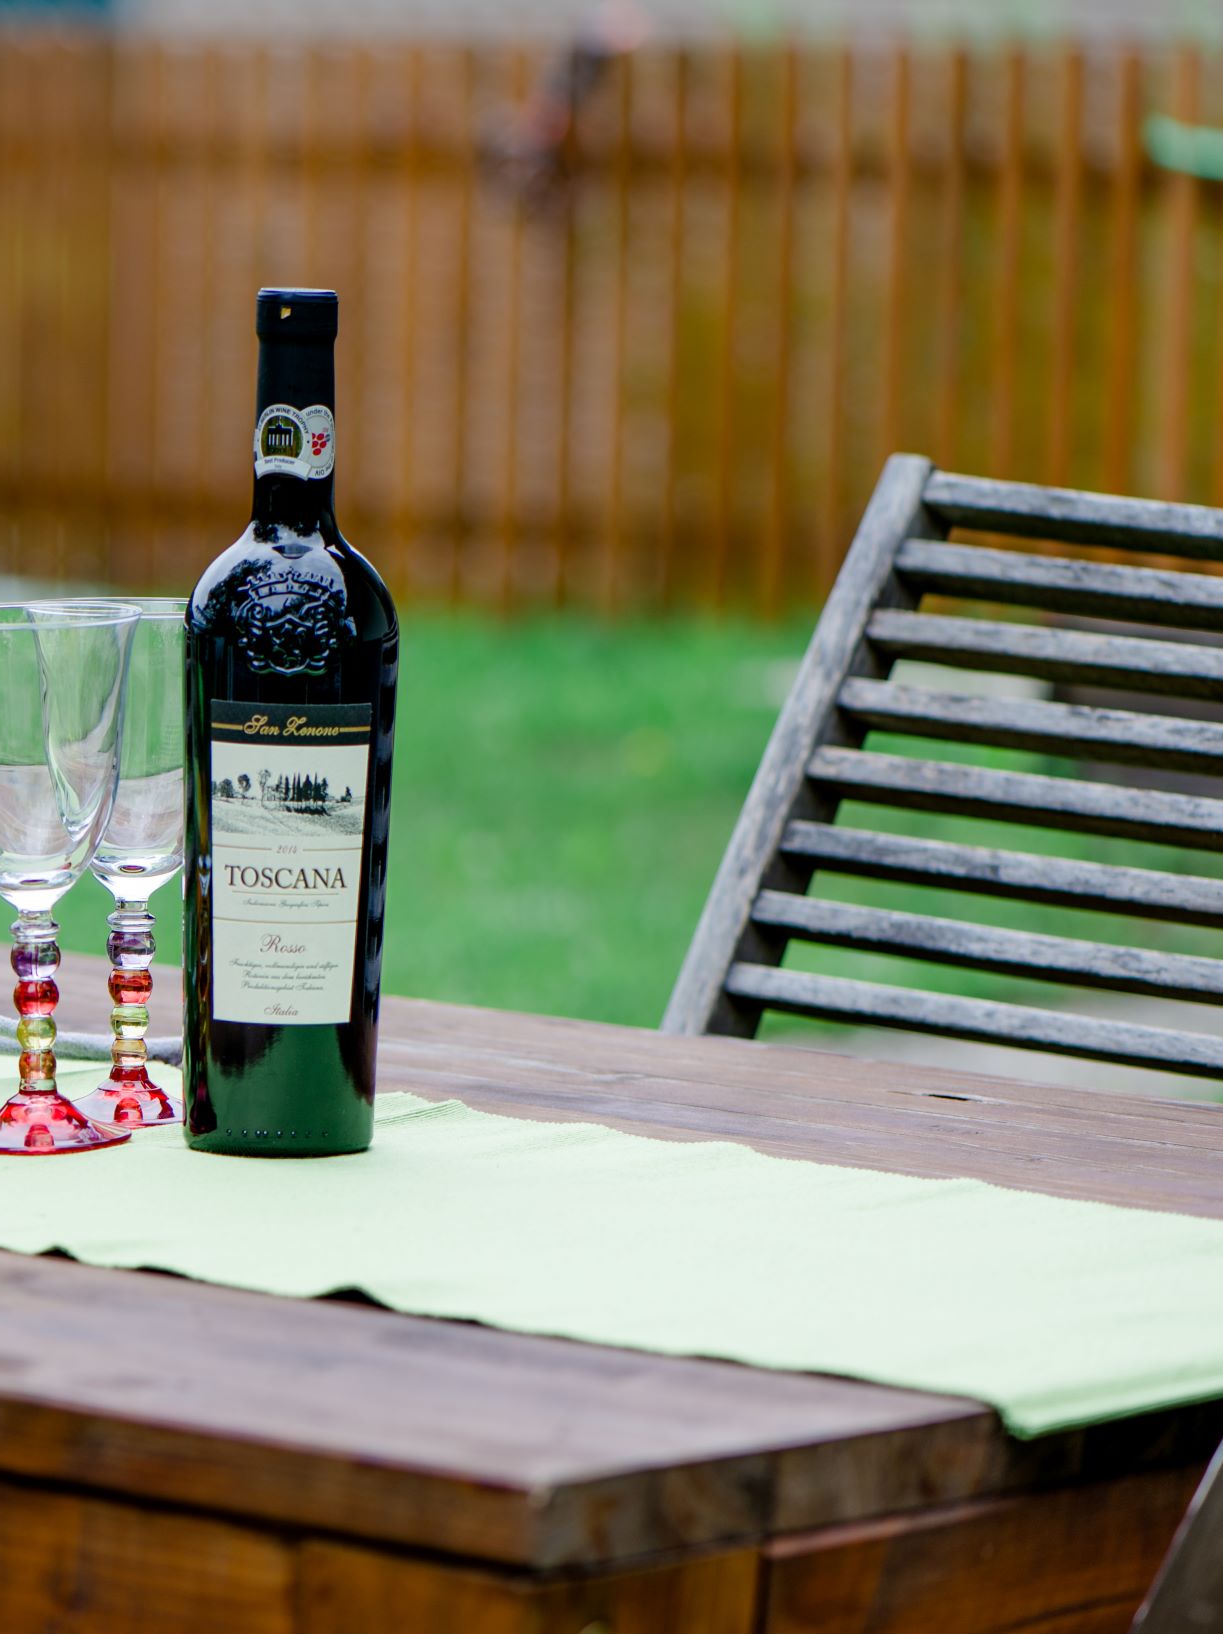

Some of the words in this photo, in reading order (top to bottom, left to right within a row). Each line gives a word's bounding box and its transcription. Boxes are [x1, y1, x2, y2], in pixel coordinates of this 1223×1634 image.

[306, 408, 322, 417] under
[243, 714, 280, 736] San
[283, 716, 340, 736] Zenone
[224, 864, 348, 890] TOSCANA
[260, 934, 306, 954] Rosso
[263, 1002, 298, 1016] Italia
